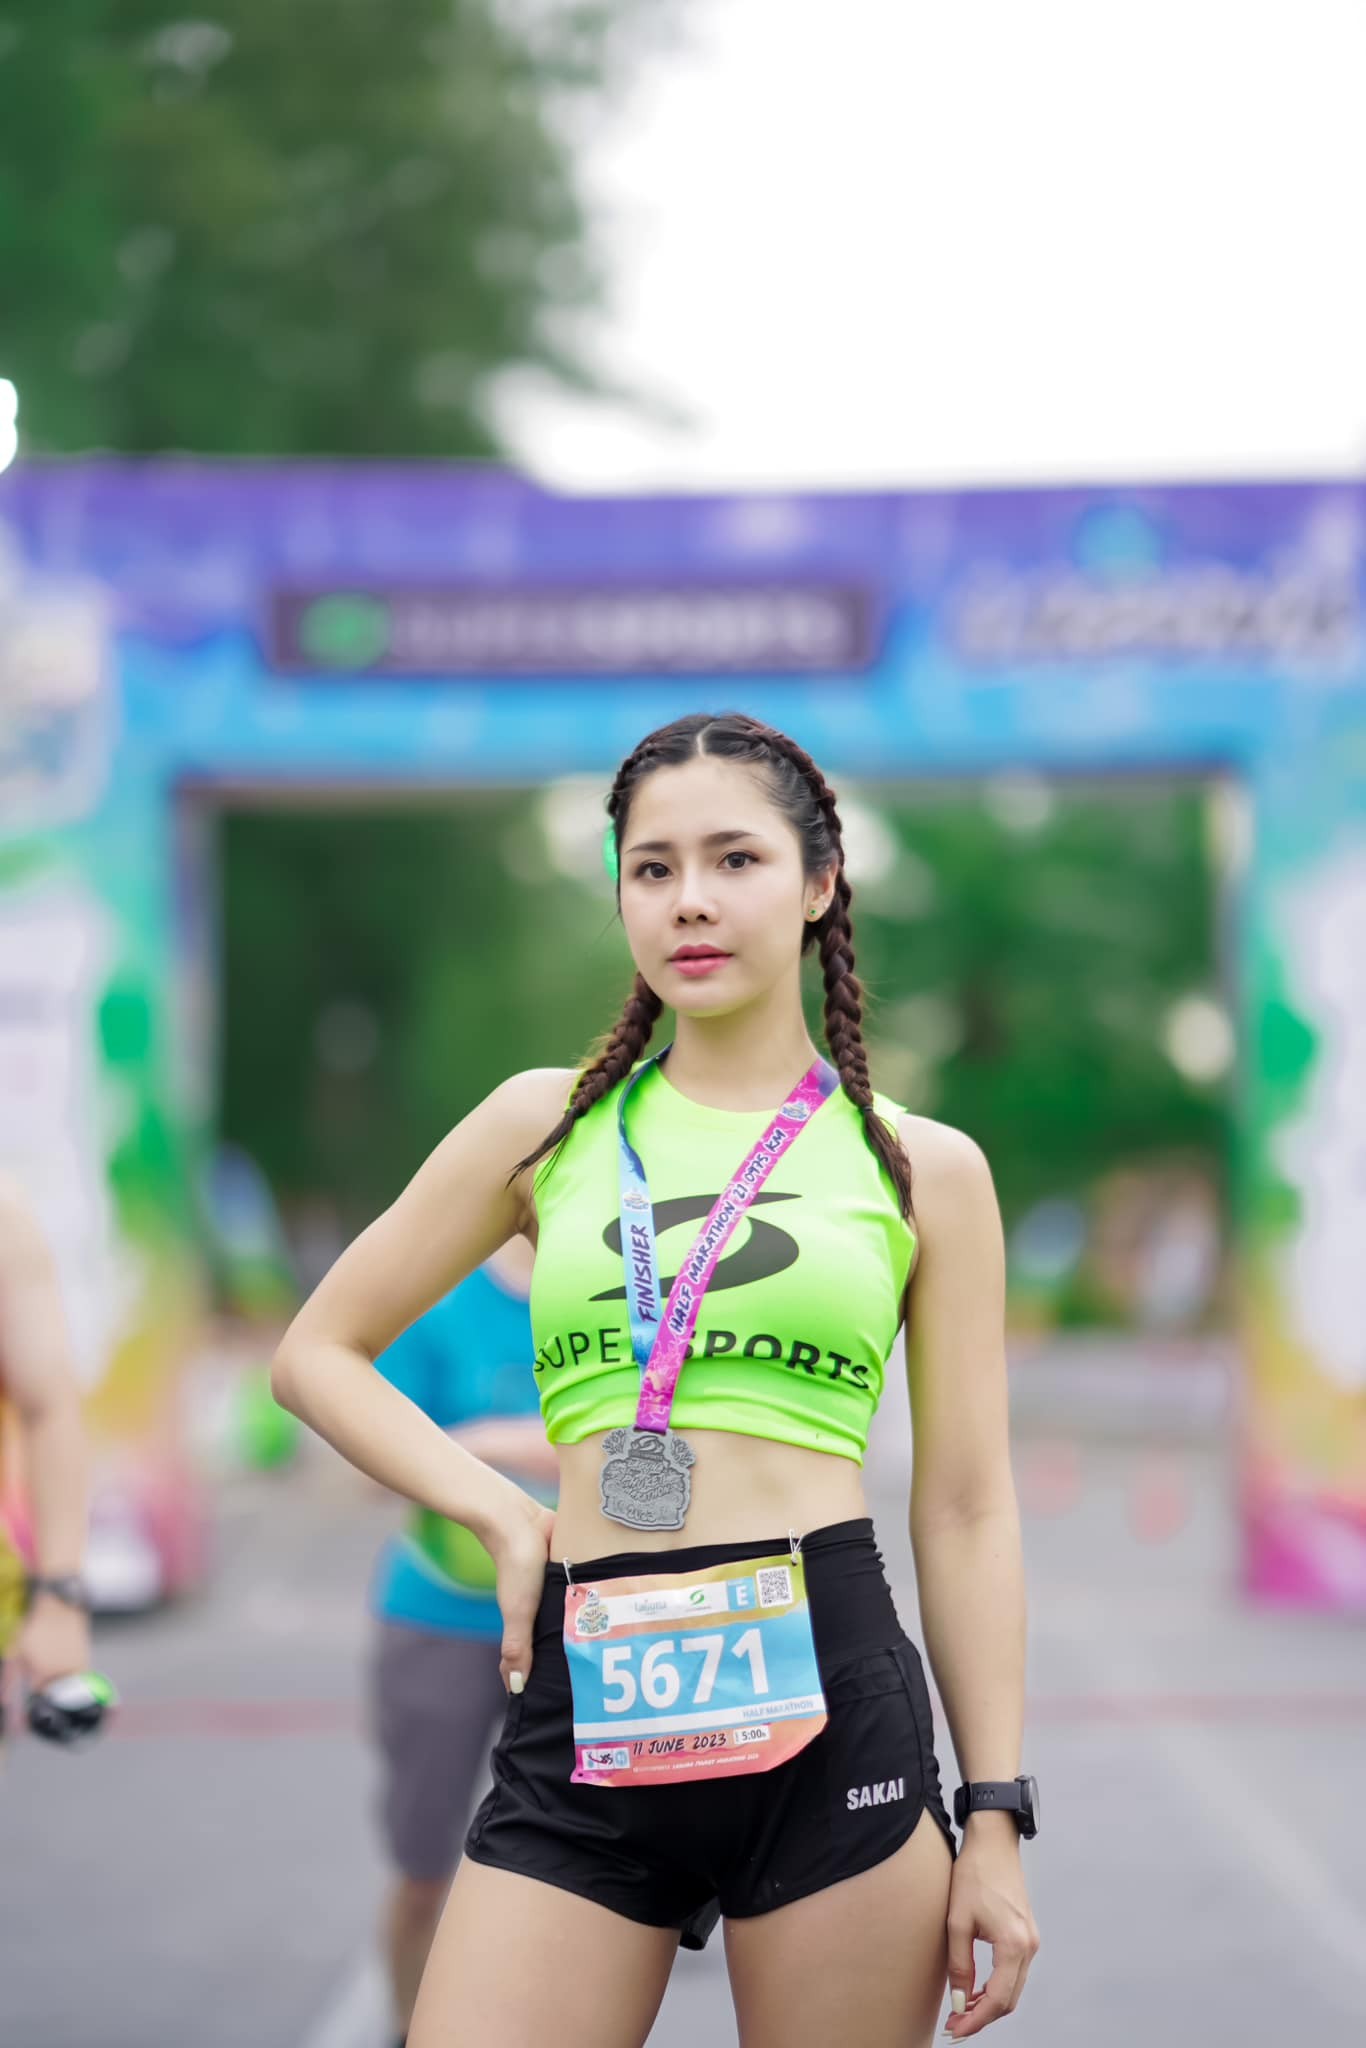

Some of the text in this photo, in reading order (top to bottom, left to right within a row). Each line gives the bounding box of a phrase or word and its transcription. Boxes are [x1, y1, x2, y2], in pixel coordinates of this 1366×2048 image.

[670, 1285, 691, 1334] HALF
[688, 1201, 736, 1283] MARATHON
[765, 1128, 786, 1153] KM
[631, 1224, 658, 1322] FINISHER
[736, 1584, 750, 1607] E
[602, 1628, 769, 1713] 5671
[766, 1701, 814, 1715] MARATHON
[633, 1741, 643, 1756] 11
[648, 1738, 685, 1754] JUNE
[694, 1733, 727, 1750] 2023
[846, 1777, 904, 1810] SAKAI
